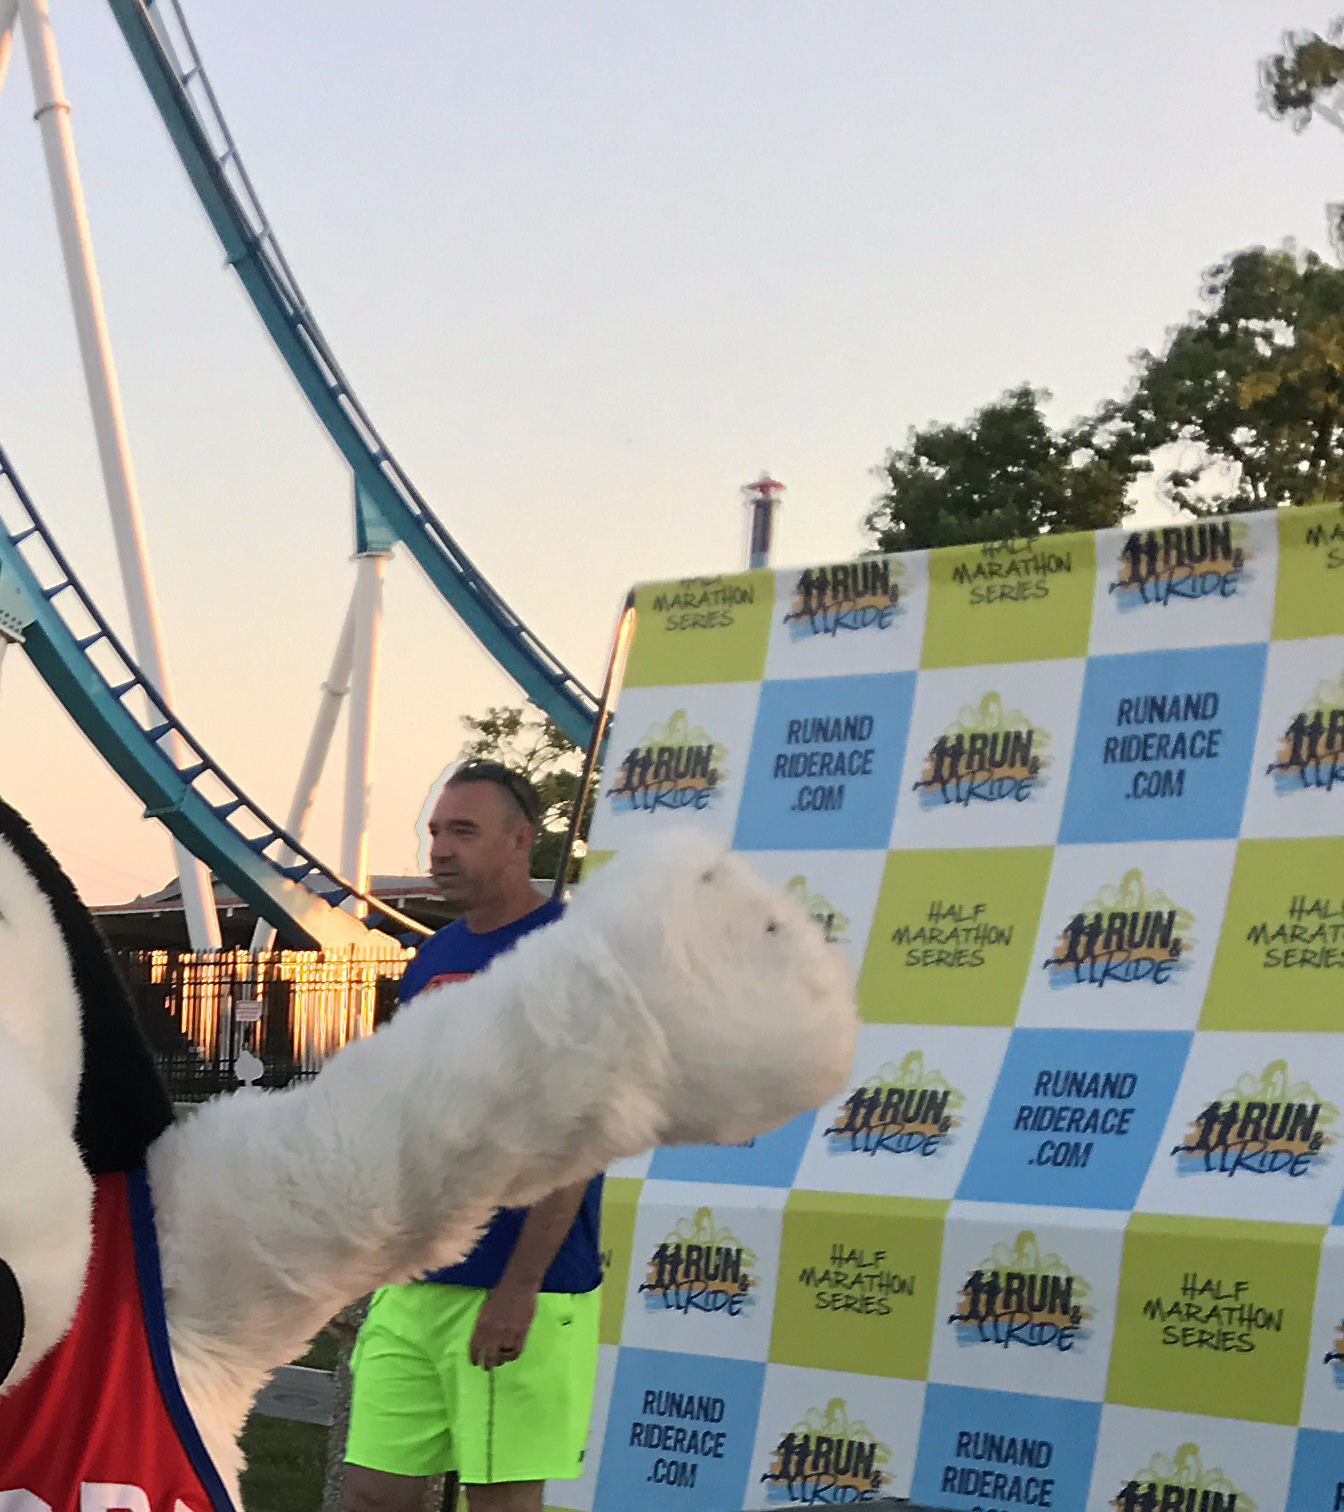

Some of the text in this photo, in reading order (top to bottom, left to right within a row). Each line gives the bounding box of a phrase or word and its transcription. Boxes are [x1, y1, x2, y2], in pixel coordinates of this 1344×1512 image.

[1162, 521, 1231, 566] RUN
[831, 560, 889, 600] RUN
[952, 552, 1071, 584] MARATHON
[1162, 564, 1242, 606] RIDE
[653, 583, 754, 612] MARATHON
[970, 578, 1049, 605] SERIES
[666, 609, 734, 631] SERIES
[829, 600, 895, 637] RIDE
[1117, 692, 1220, 726] RUNAND
[786, 715, 874, 745] RUNAND
[1103, 729, 1222, 764] RIDERACE
[653, 744, 714, 780] RUN
[773, 749, 875, 779] RIDERACE
[966, 730, 1034, 769] RUN
[649, 780, 715, 814] RIDE
[791, 786, 845, 812] .COM
[964, 768, 1037, 807] RIDE
[1124, 769, 1185, 799] .COM
[928, 900, 987, 923] HALF
[1289, 895, 1344, 921] HAL
[891, 922, 1014, 947] MARATHON
[1103, 910, 1177, 950] RUN
[905, 947, 985, 968] SERIES
[1098, 949, 1179, 988] RIDE
[1034, 1070, 1137, 1100] RUNAND
[878, 1087, 951, 1124] RUN
[1014, 1106, 1136, 1136] RIDERACE
[1236, 1101, 1322, 1142] RUN
[870, 1120, 946, 1157] RIDE
[1027, 1141, 1094, 1169] .COM
[1227, 1138, 1318, 1177] RIDE
[683, 1244, 743, 1283] RUN
[830, 1243, 886, 1268] HALF
[682, 1279, 748, 1316] RIDE
[798, 1266, 915, 1297] MARATHON
[1003, 1271, 1075, 1315] RUN
[1181, 1272, 1250, 1301] HALF
[815, 1291, 892, 1316] SERIES
[1142, 1298, 1285, 1332] MARATHON
[1003, 1310, 1080, 1351] RIDE
[1162, 1325, 1256, 1353] SERIES
[642, 1389, 726, 1424] RUNAND
[629, 1422, 727, 1459] RIDERACE
[810, 1435, 877, 1480] RUN
[955, 1430, 1054, 1470] RUNAND
[647, 1457, 698, 1489] .COM
[941, 1465, 1055, 1508] RIDERACE
